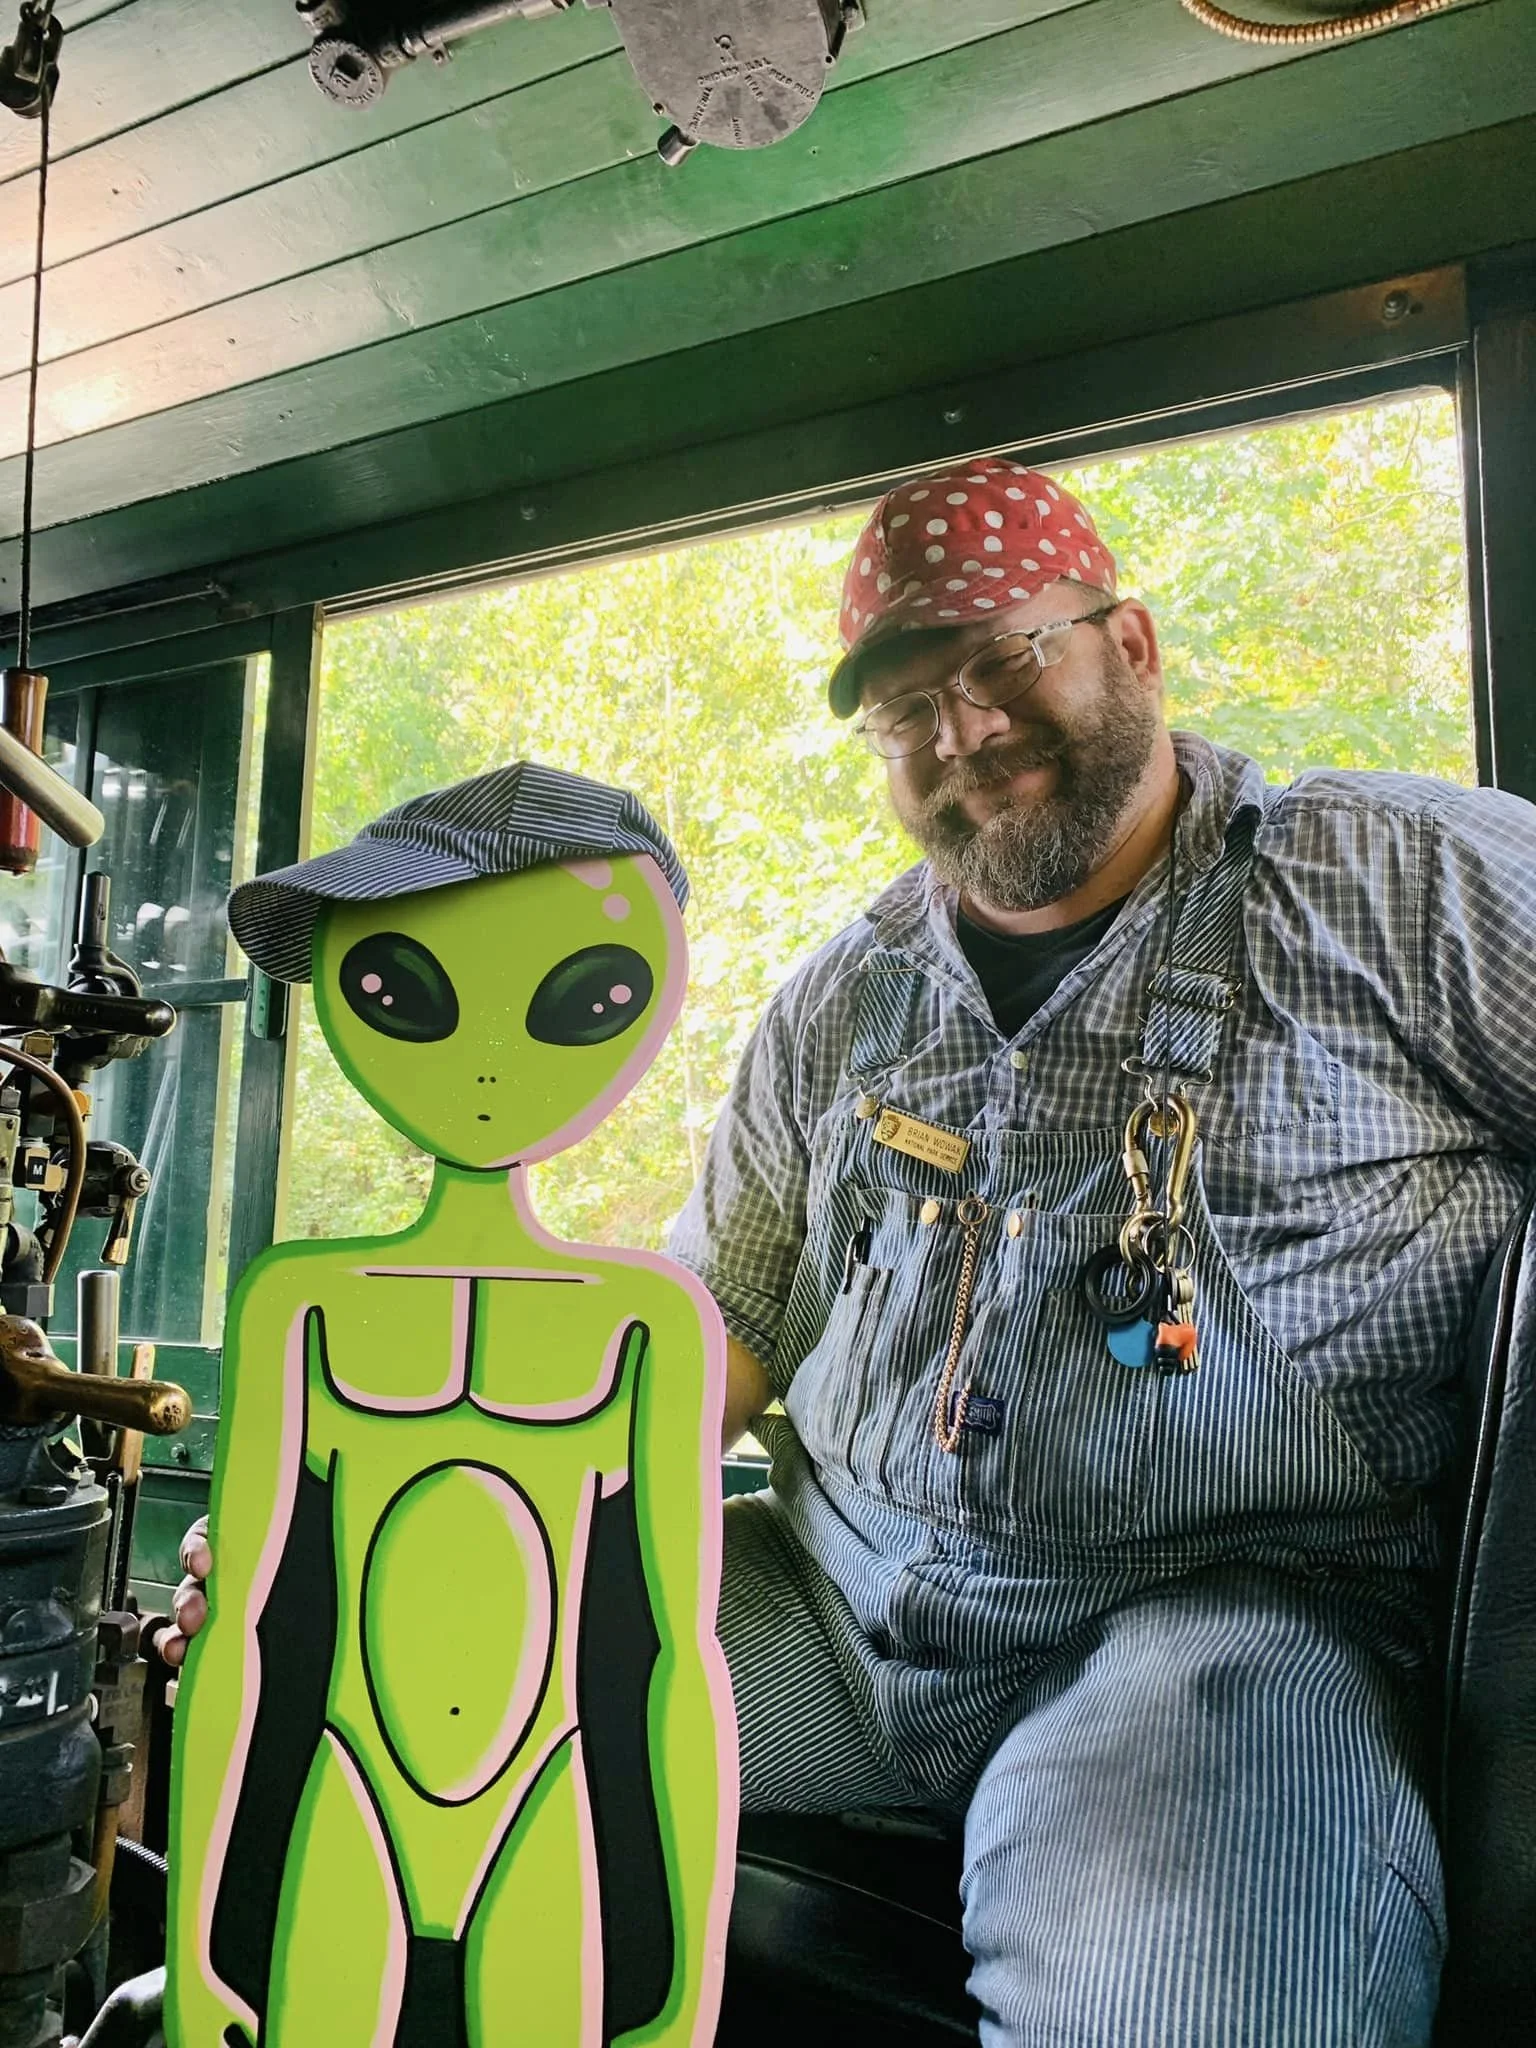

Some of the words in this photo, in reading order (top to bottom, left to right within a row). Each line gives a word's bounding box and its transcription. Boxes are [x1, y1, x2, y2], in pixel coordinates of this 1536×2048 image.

[906, 1126, 929, 1143] BRIAN
[904, 1139, 925, 1152] NATIONAL
[927, 1147, 938, 1157] PARK
[32, 1163, 43, 1176] M
